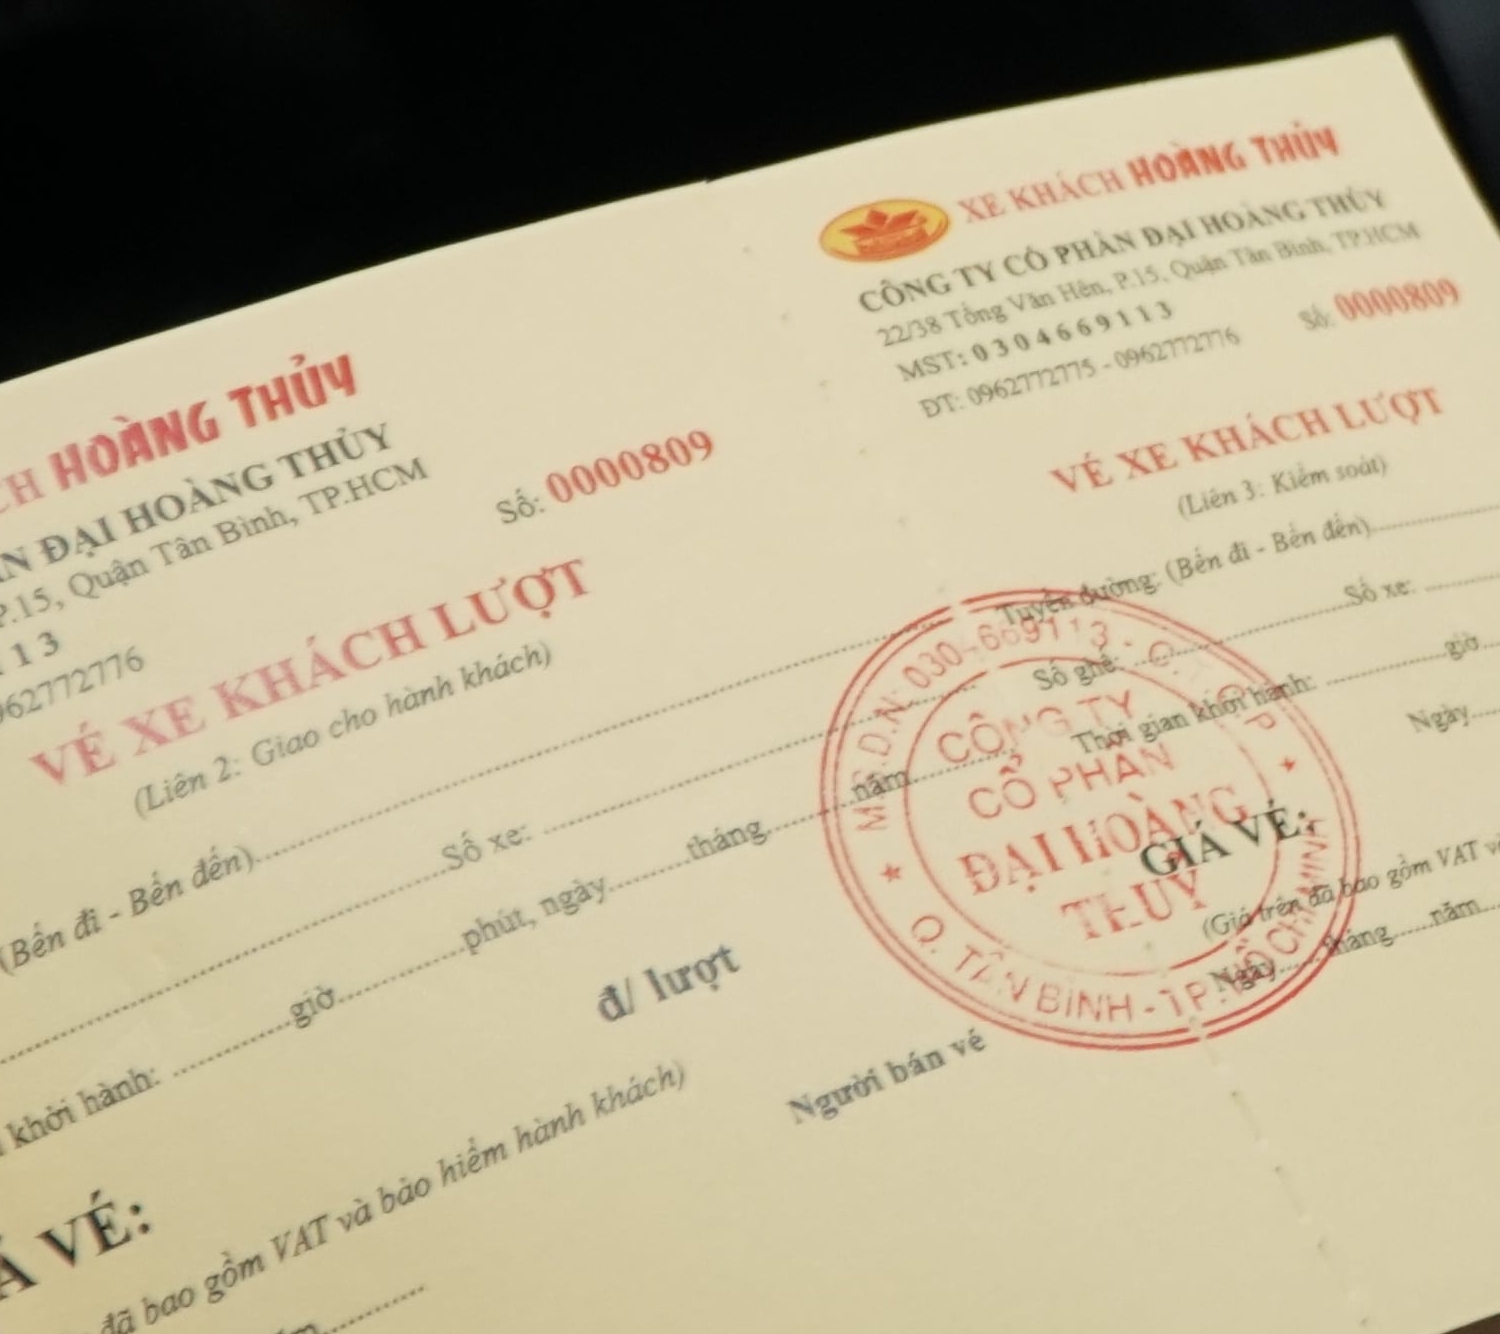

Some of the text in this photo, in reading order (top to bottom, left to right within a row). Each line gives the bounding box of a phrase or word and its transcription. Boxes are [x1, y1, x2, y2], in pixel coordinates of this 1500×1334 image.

[959, 126, 1341, 222] XE KHÁCH HOÀNG THỦY
[858, 272, 953, 313] CÔNG
[953, 261, 996, 288] TY
[1140, 219, 1197, 248] ĐẠI
[1198, 201, 1308, 237] HOÀNG
[1333, 278, 1461, 319] 0000809
[877, 315, 944, 348] 22/38
[896, 349, 969, 382] MST:
[50, 401, 221, 489] HOÀNG
[227, 353, 357, 427] THỦY
[1050, 385, 1443, 492] VÉ XE KHÁCH LƯỢT
[38, 516, 117, 565] ĐẠI
[121, 463, 275, 535] HOÀNG
[276, 423, 390, 479] THỦY
[495, 429, 715, 525] Số: 0000809
[1177, 488, 1239, 518] (Liên
[1270, 466, 1331, 495] Kiểm
[67, 557, 151, 600] Quận
[149, 535, 214, 567] Tân
[212, 505, 300, 546] Bình,
[297, 456, 429, 516] TP.HCM
[1164, 512, 1373, 585] (Bến đi Bến đến)
[1349, 577, 1379, 607] Số
[31, 560, 586, 785] VÉ XE KHÁCH LƯỢT
[1077, 689, 1134, 722] TY
[1406, 704, 1470, 734] Ngày
[133, 643, 553, 819] (Liên 2: Giao cho hành khách)
[73, 907, 103, 941] đi
[128, 870, 185, 917] Bến
[191, 845, 255, 890] đến)
[441, 825, 532, 872] Số xe:
[958, 831, 1062, 895] ĐẠI
[1139, 819, 1232, 876] GIÁ
[1386, 858, 1433, 890] gồm
[1435, 839, 1478, 867] VAT
[5, 1105, 77, 1149] khởi
[76, 1068, 161, 1117] hành:
[289, 985, 336, 1030] giờ
[460, 908, 538, 957] phút,
[538, 877, 606, 917] ngày
[685, 820, 769, 861] tháng
[850, 769, 912, 803] năm
[1429, 899, 1482, 927] năm
[38, 1189, 151, 1266] VÉ:
[643, 944, 741, 1002] lượt
[787, 1027, 987, 1124] Người bán vé
[141, 1286, 198, 1326] bao
[204, 1251, 266, 1305] gồm
[270, 1212, 330, 1262] VAT
[336, 1197, 374, 1232] và
[377, 1176, 433, 1215] bảo
[437, 1137, 509, 1187] hiểm
[513, 1102, 586, 1154] hành
[590, 1064, 686, 1118] khách)
